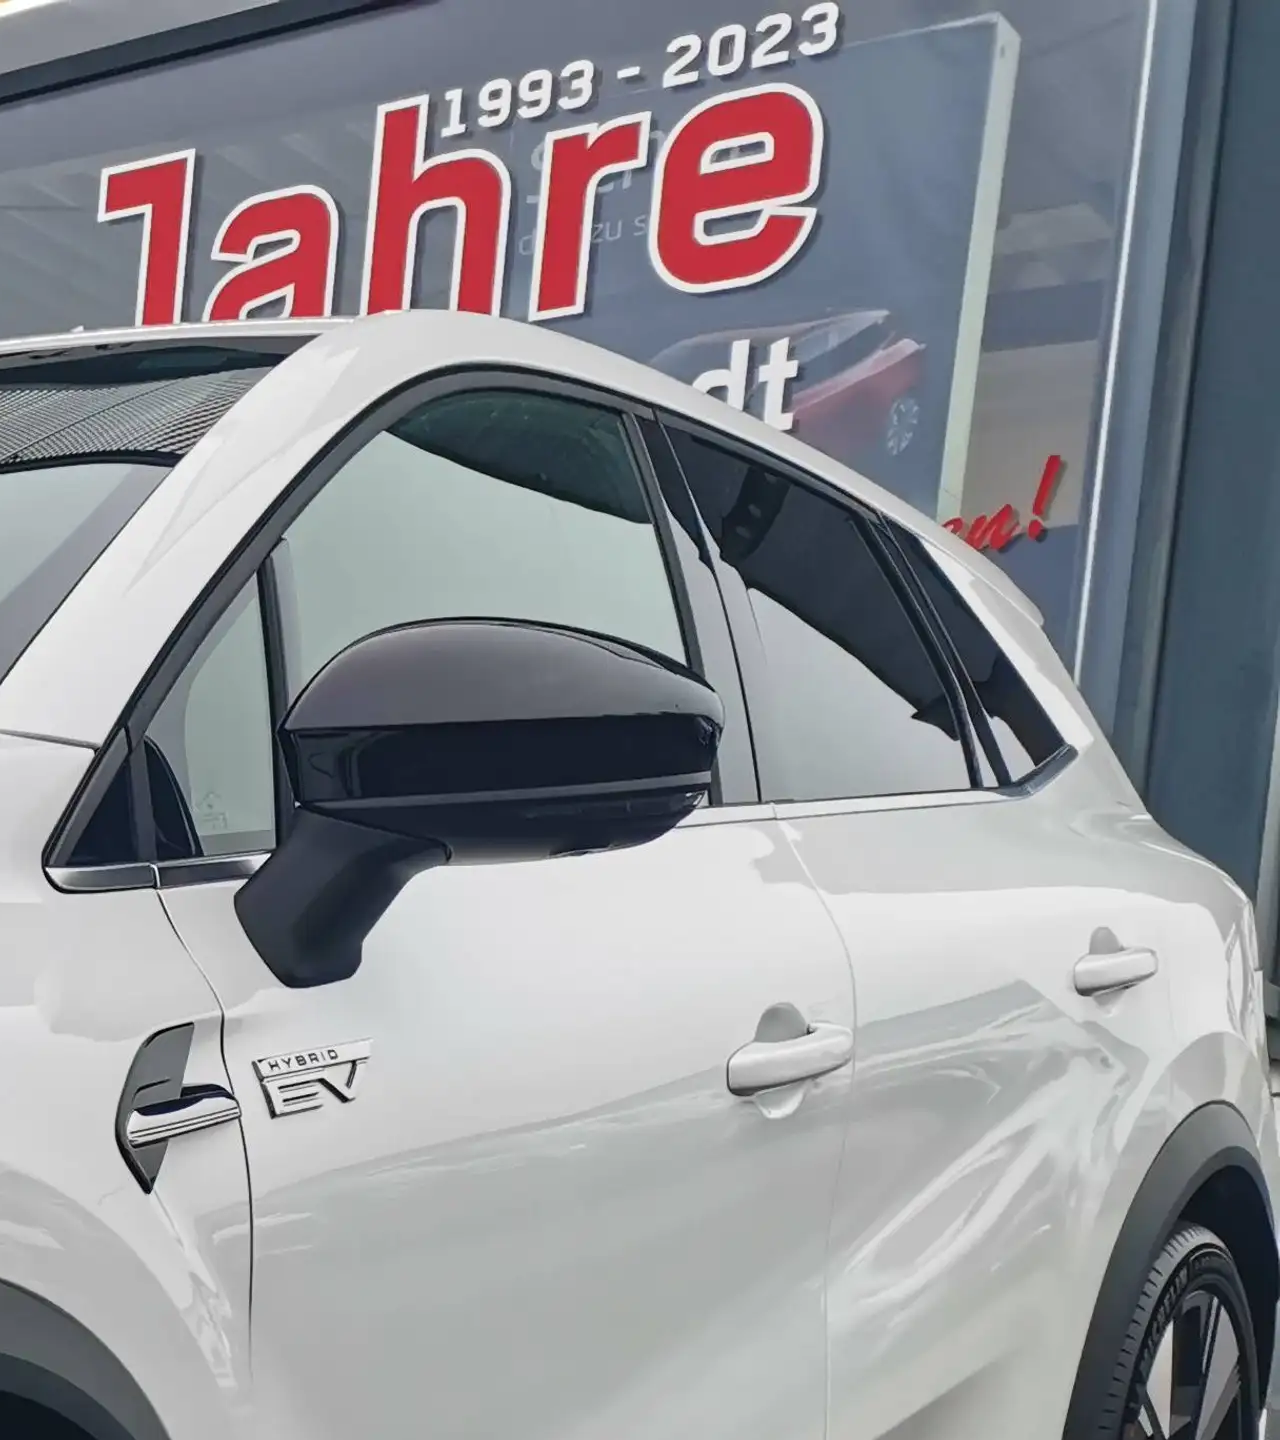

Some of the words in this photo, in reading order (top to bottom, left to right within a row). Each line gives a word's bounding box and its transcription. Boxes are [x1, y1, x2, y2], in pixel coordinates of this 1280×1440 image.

[441, 59, 595, 138] 1993
[662, 1, 840, 88] 2023
[97, 82, 825, 326] Jahre
[267, 1048, 340, 1072] HYBRID
